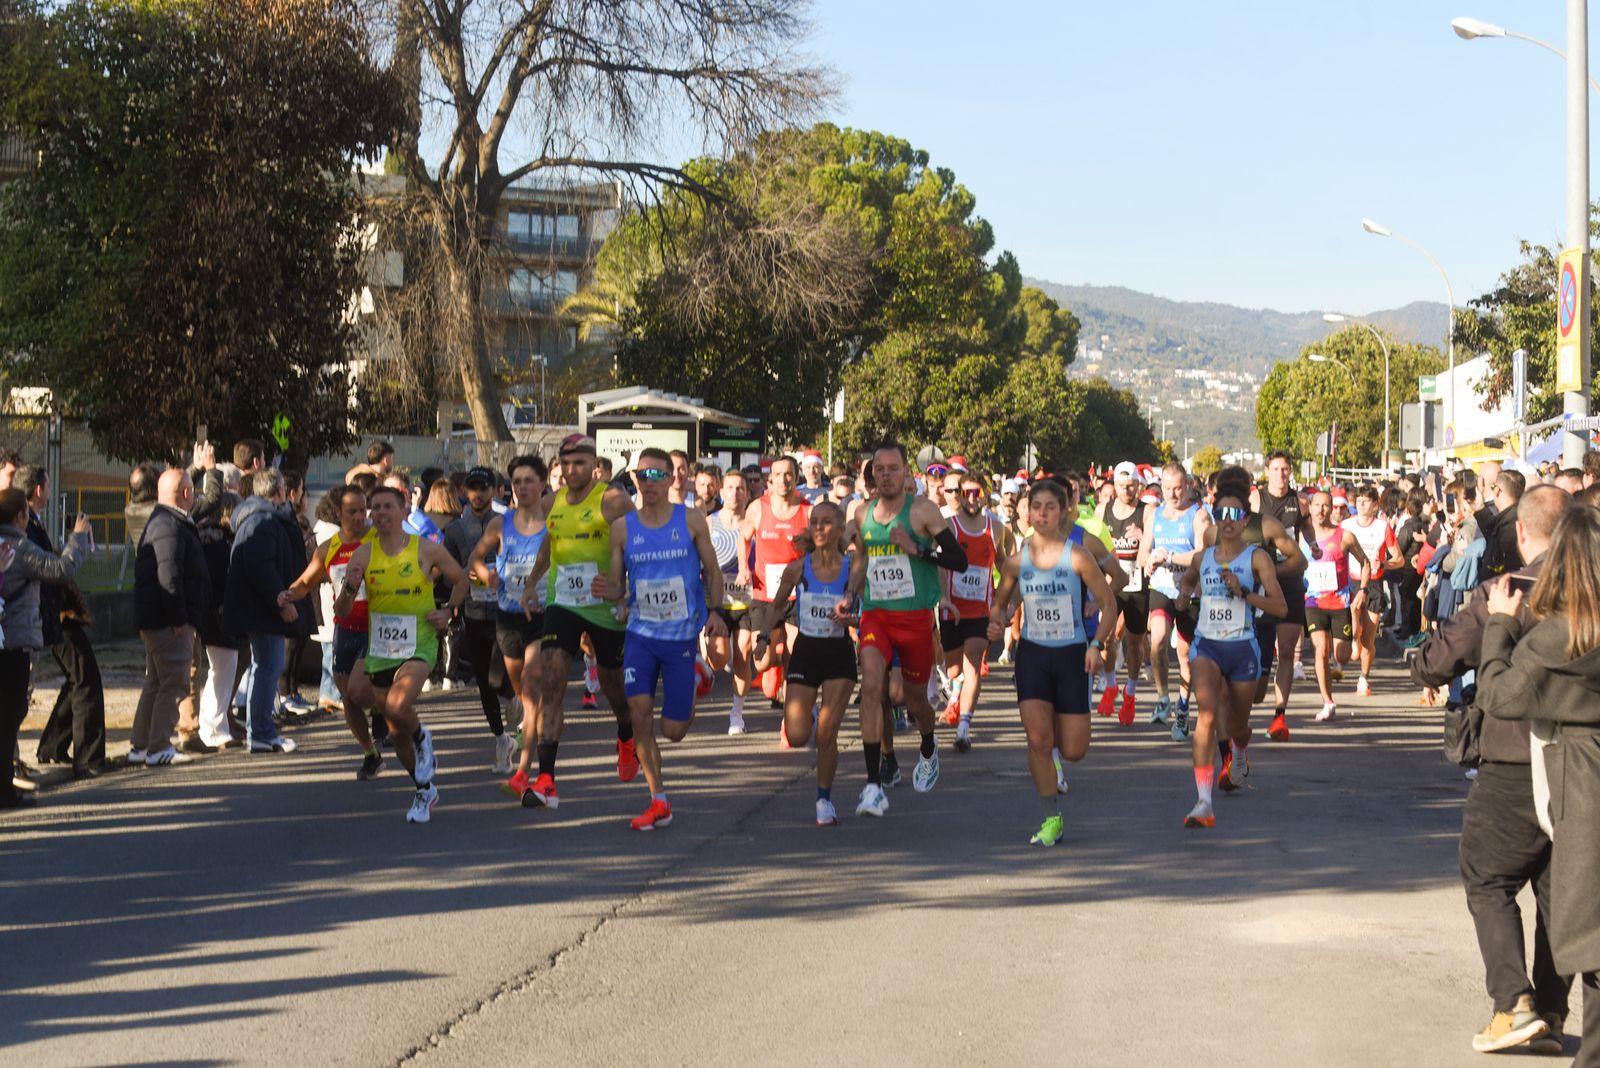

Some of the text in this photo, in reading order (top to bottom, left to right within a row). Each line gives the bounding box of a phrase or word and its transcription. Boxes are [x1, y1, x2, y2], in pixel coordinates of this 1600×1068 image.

[873, 568, 904, 582] 1139
[961, 575, 981, 586] 486
[568, 577, 584, 590] 36
[1025, 580, 1068, 595] nerja
[644, 590, 678, 605] 1126
[1036, 608, 1061, 621] 885
[1209, 608, 1233, 621] 858
[377, 626, 408, 641] 1524
